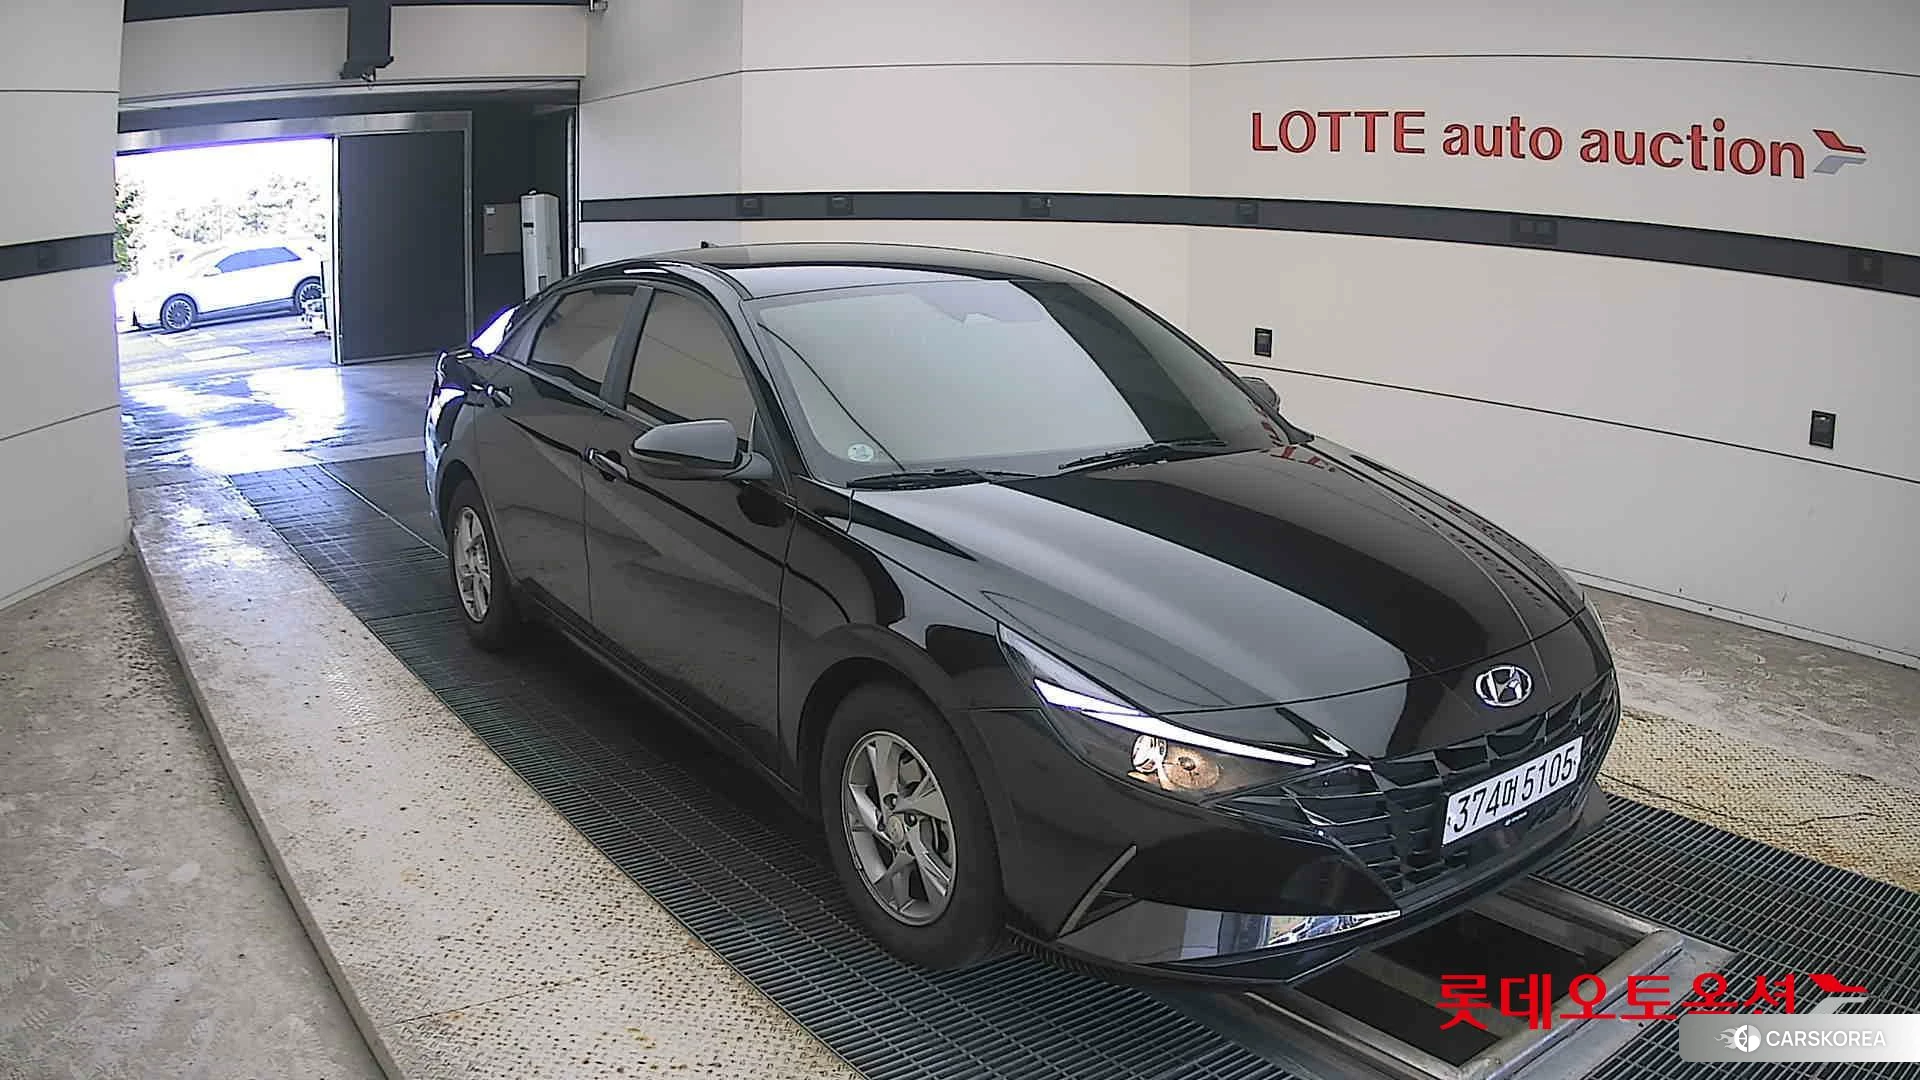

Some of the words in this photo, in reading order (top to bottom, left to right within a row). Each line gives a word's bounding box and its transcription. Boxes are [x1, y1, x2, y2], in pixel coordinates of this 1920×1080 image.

[1251, 110, 1426, 155] LOTTE
[1442, 115, 1564, 161] auto
[1579, 118, 1806, 179] auction
[1454, 776, 1520, 833] 374머
[1521, 746, 1577, 801] 5105
